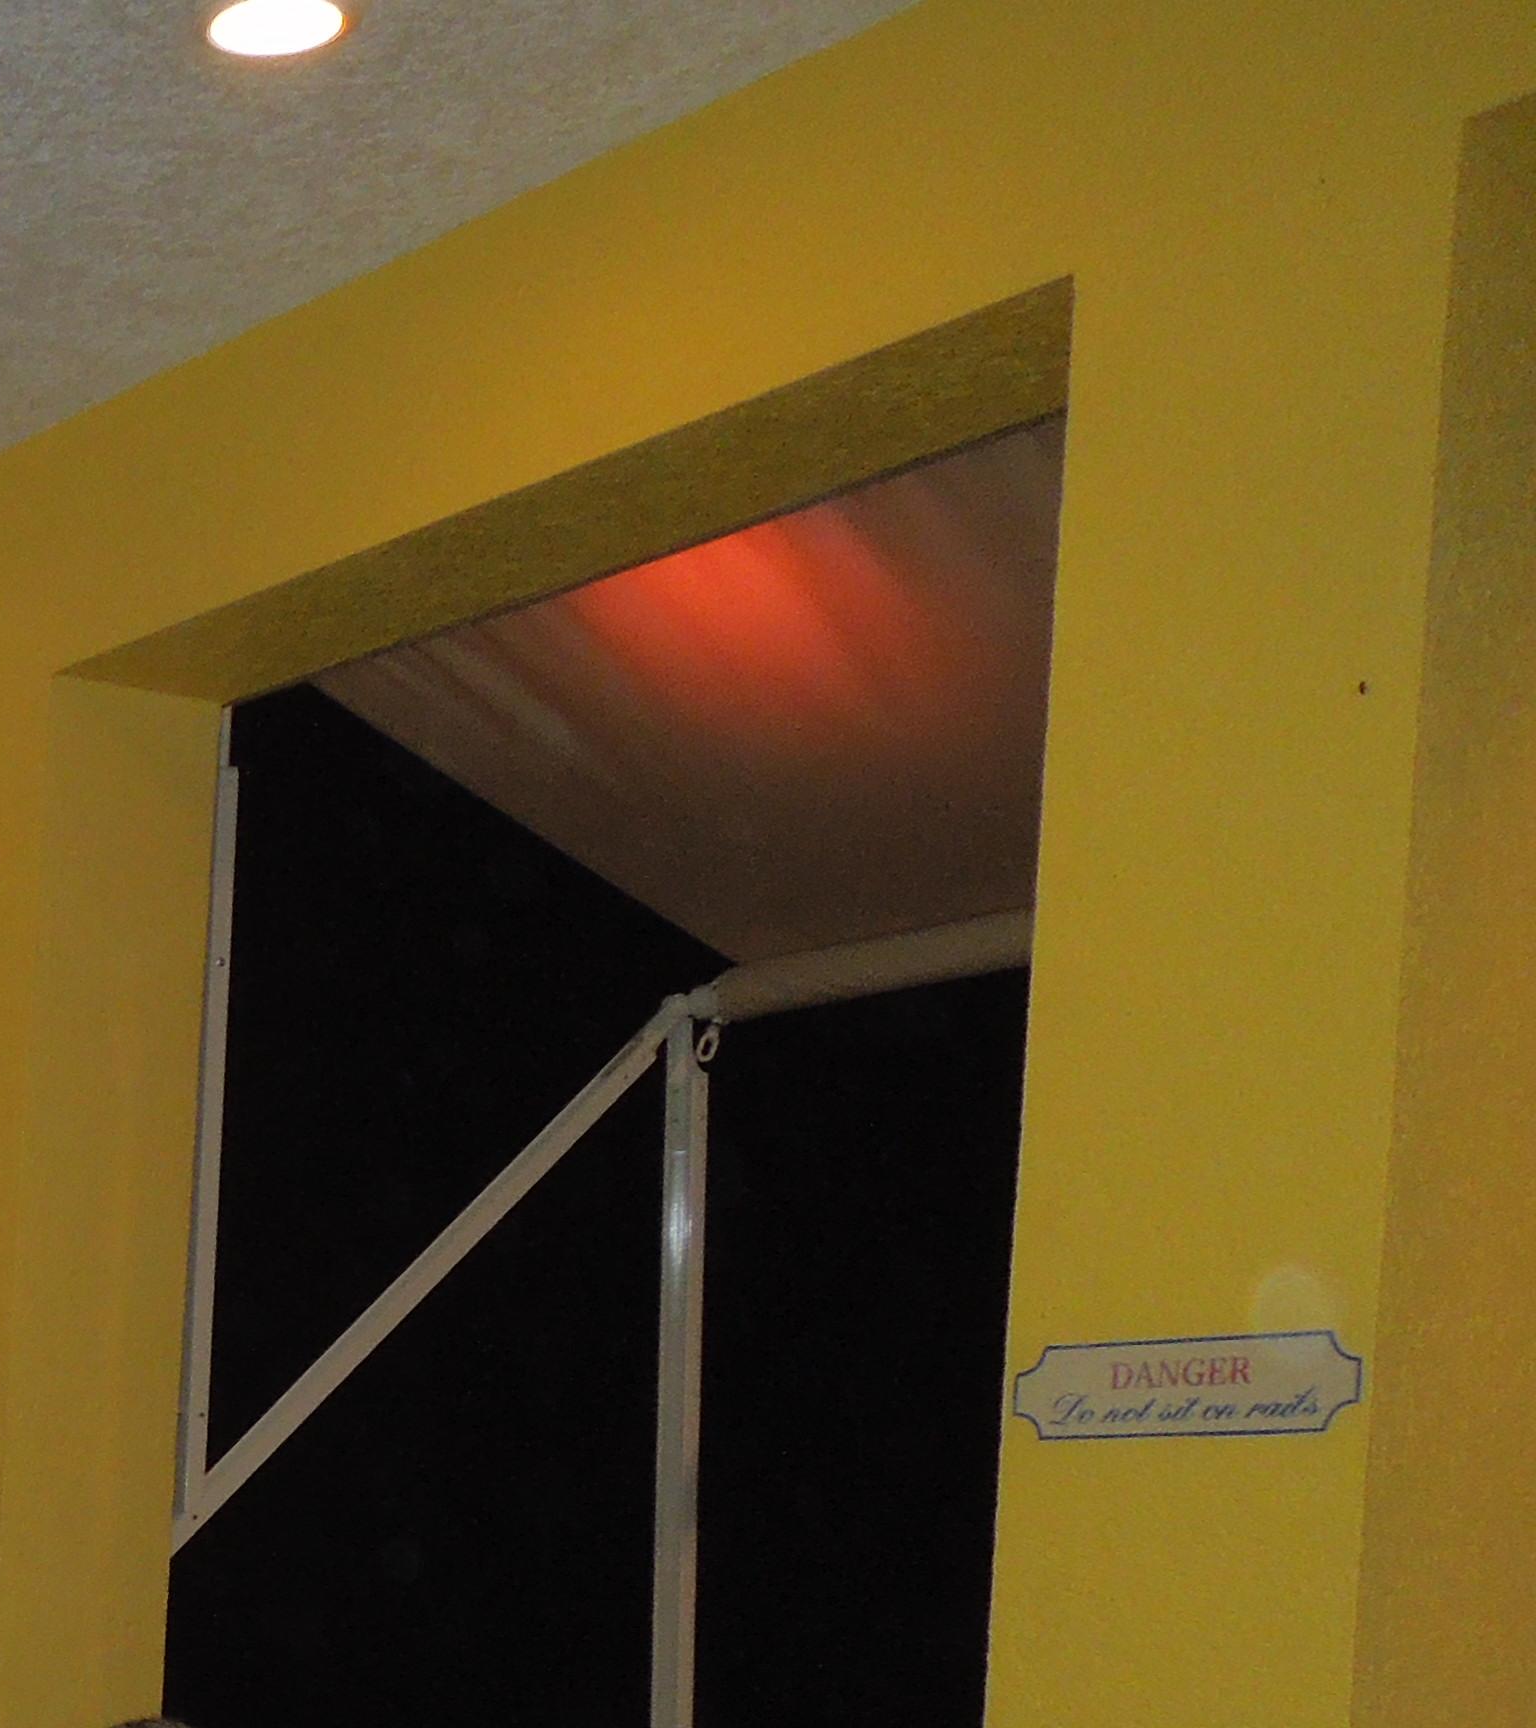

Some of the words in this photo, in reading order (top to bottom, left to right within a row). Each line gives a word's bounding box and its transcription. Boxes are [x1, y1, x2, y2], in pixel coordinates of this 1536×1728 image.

[1111, 1357, 1253, 1389] DANGER
[1049, 1392, 1095, 1426] Do
[1102, 1399, 1153, 1425] not
[1158, 1399, 1196, 1421] sit
[1202, 1403, 1237, 1421] on
[1245, 1386, 1320, 1419] rails
